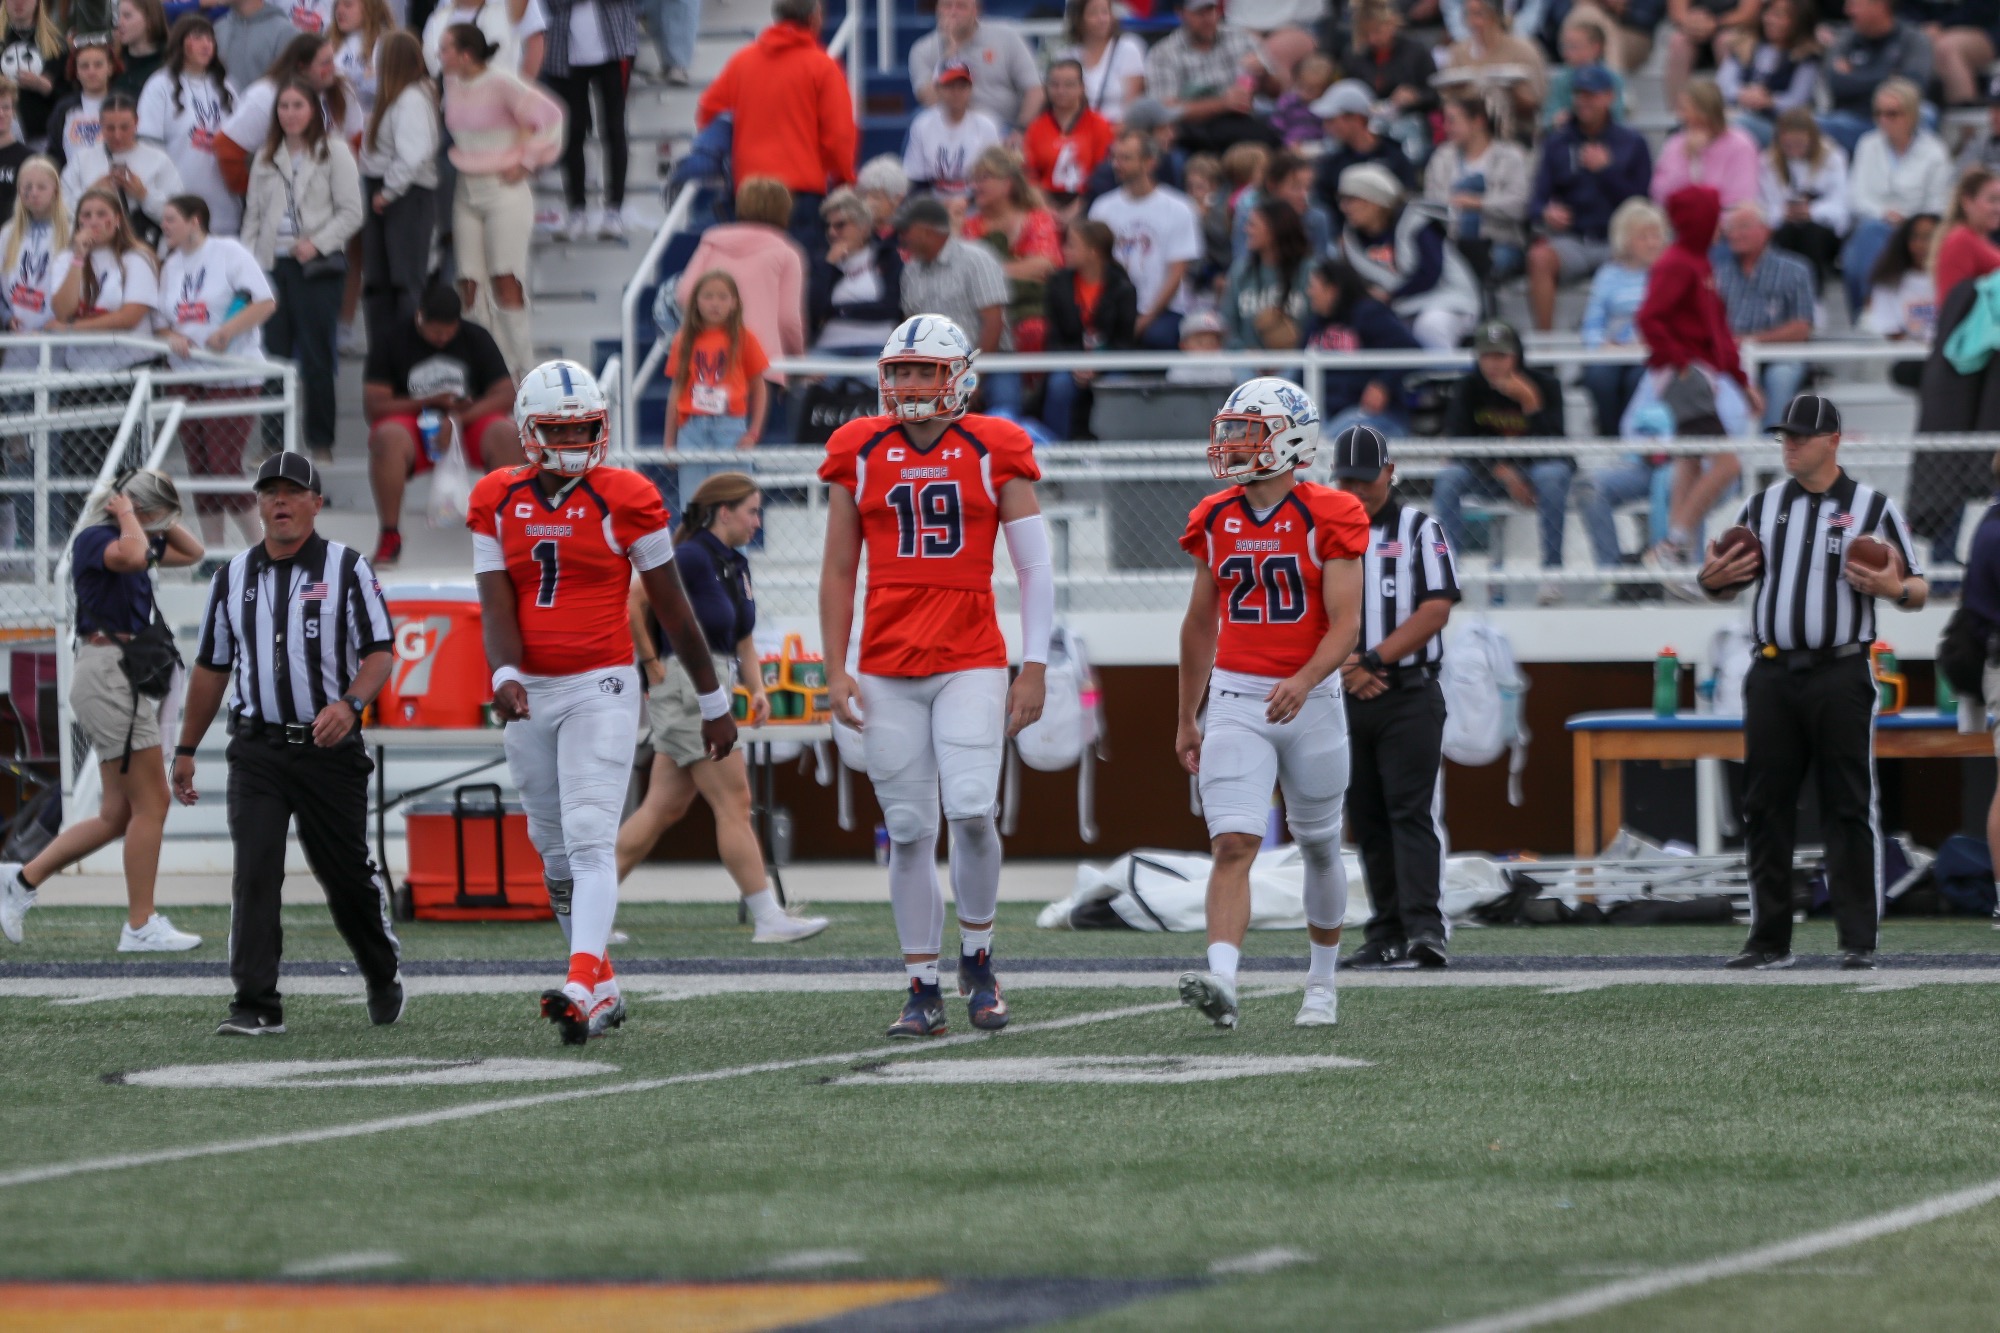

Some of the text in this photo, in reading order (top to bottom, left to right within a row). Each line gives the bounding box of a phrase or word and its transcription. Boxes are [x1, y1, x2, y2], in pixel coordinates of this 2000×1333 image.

[886, 449, 905, 462] C
[901, 467, 948, 479] BADGERS
[514, 503, 533, 518] C
[885, 481, 963, 558] 19
[525, 525, 572, 537] BADGERS
[1224, 518, 1242, 533] C
[1235, 540, 1280, 551] BADGERS
[1826, 537, 1841, 555] H
[531, 539, 559, 608] 1
[1217, 555, 1307, 624] 20
[1381, 578, 1396, 597] C
[305, 619, 319, 638] S
[395, 622, 426, 661] G
